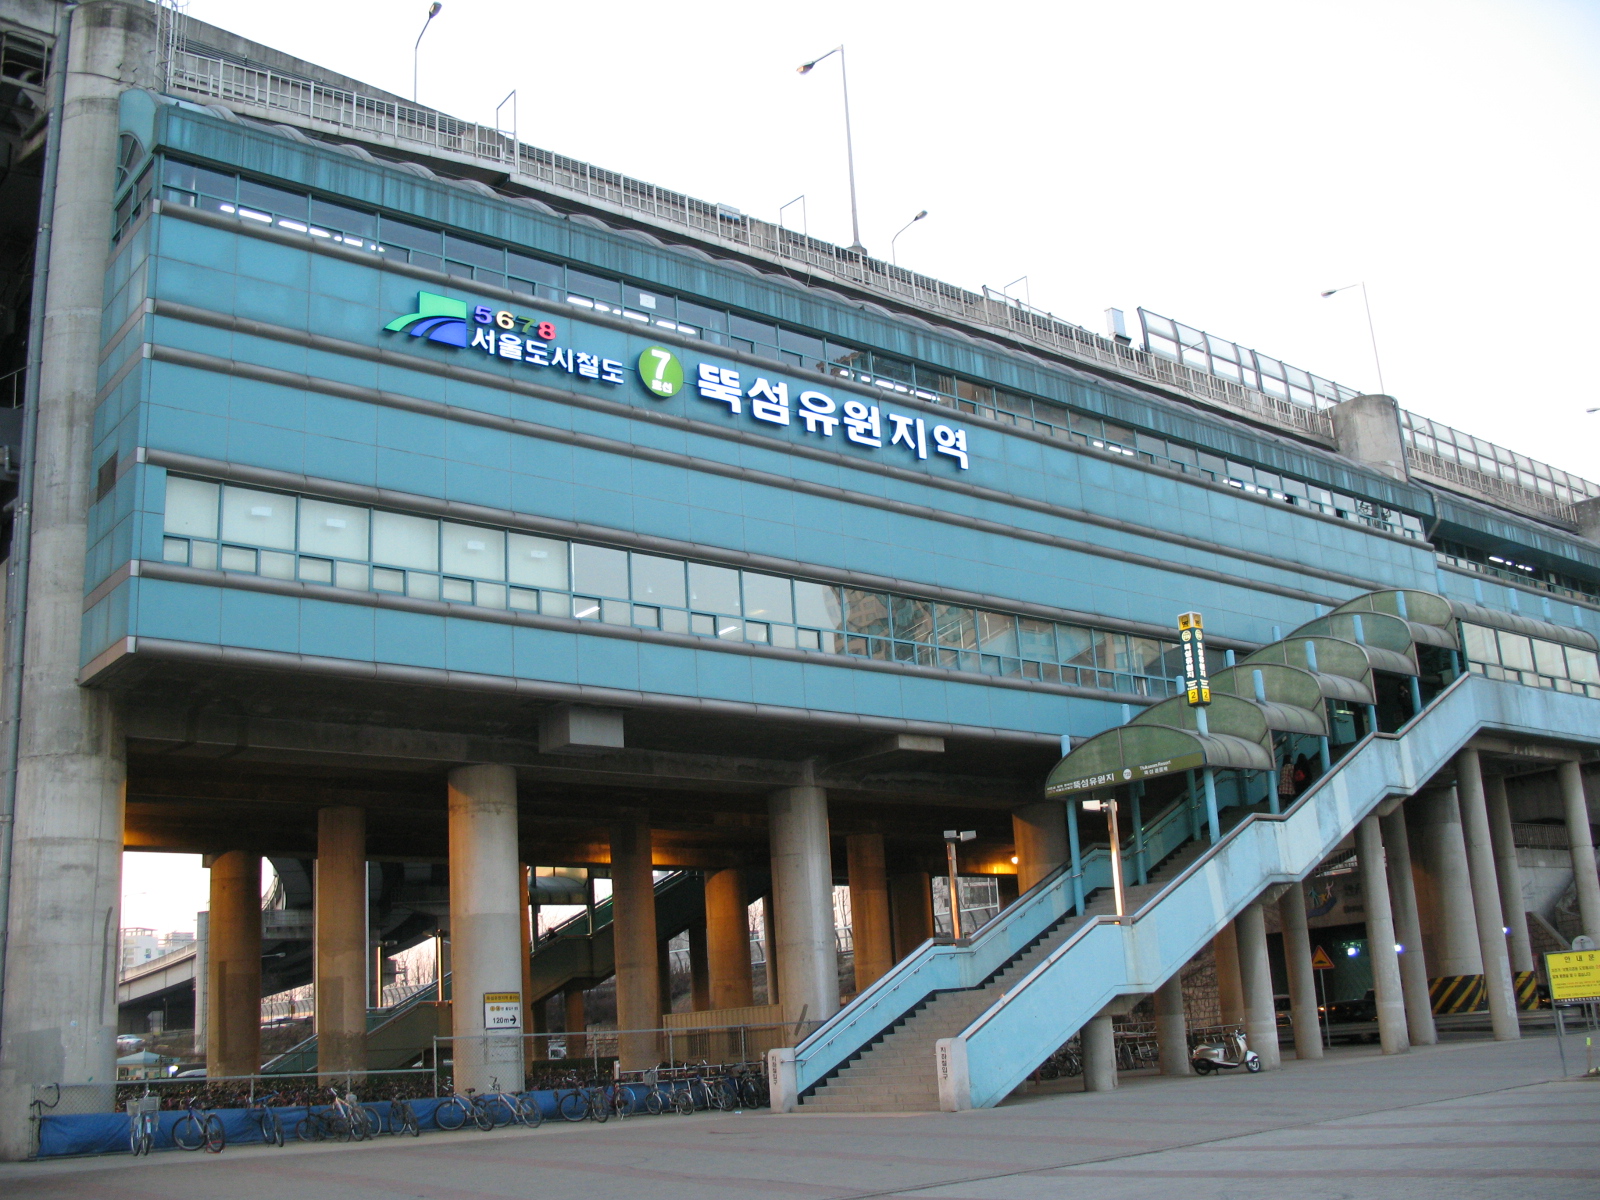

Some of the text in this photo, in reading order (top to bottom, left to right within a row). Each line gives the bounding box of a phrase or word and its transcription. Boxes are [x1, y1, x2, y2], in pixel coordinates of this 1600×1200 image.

[473, 305, 557, 341] 5678
[471, 327, 624, 385] 서울도시철도
[651, 349, 671, 380] 7
[697, 362, 969, 470] 뚝섬유원지역
[1191, 691, 1196, 699] 2
[1073, 773, 1115, 789] 뚝섬유원지
[492, 1016, 510, 1024] 120m
[940, 1046, 949, 1080] 지하철입구
